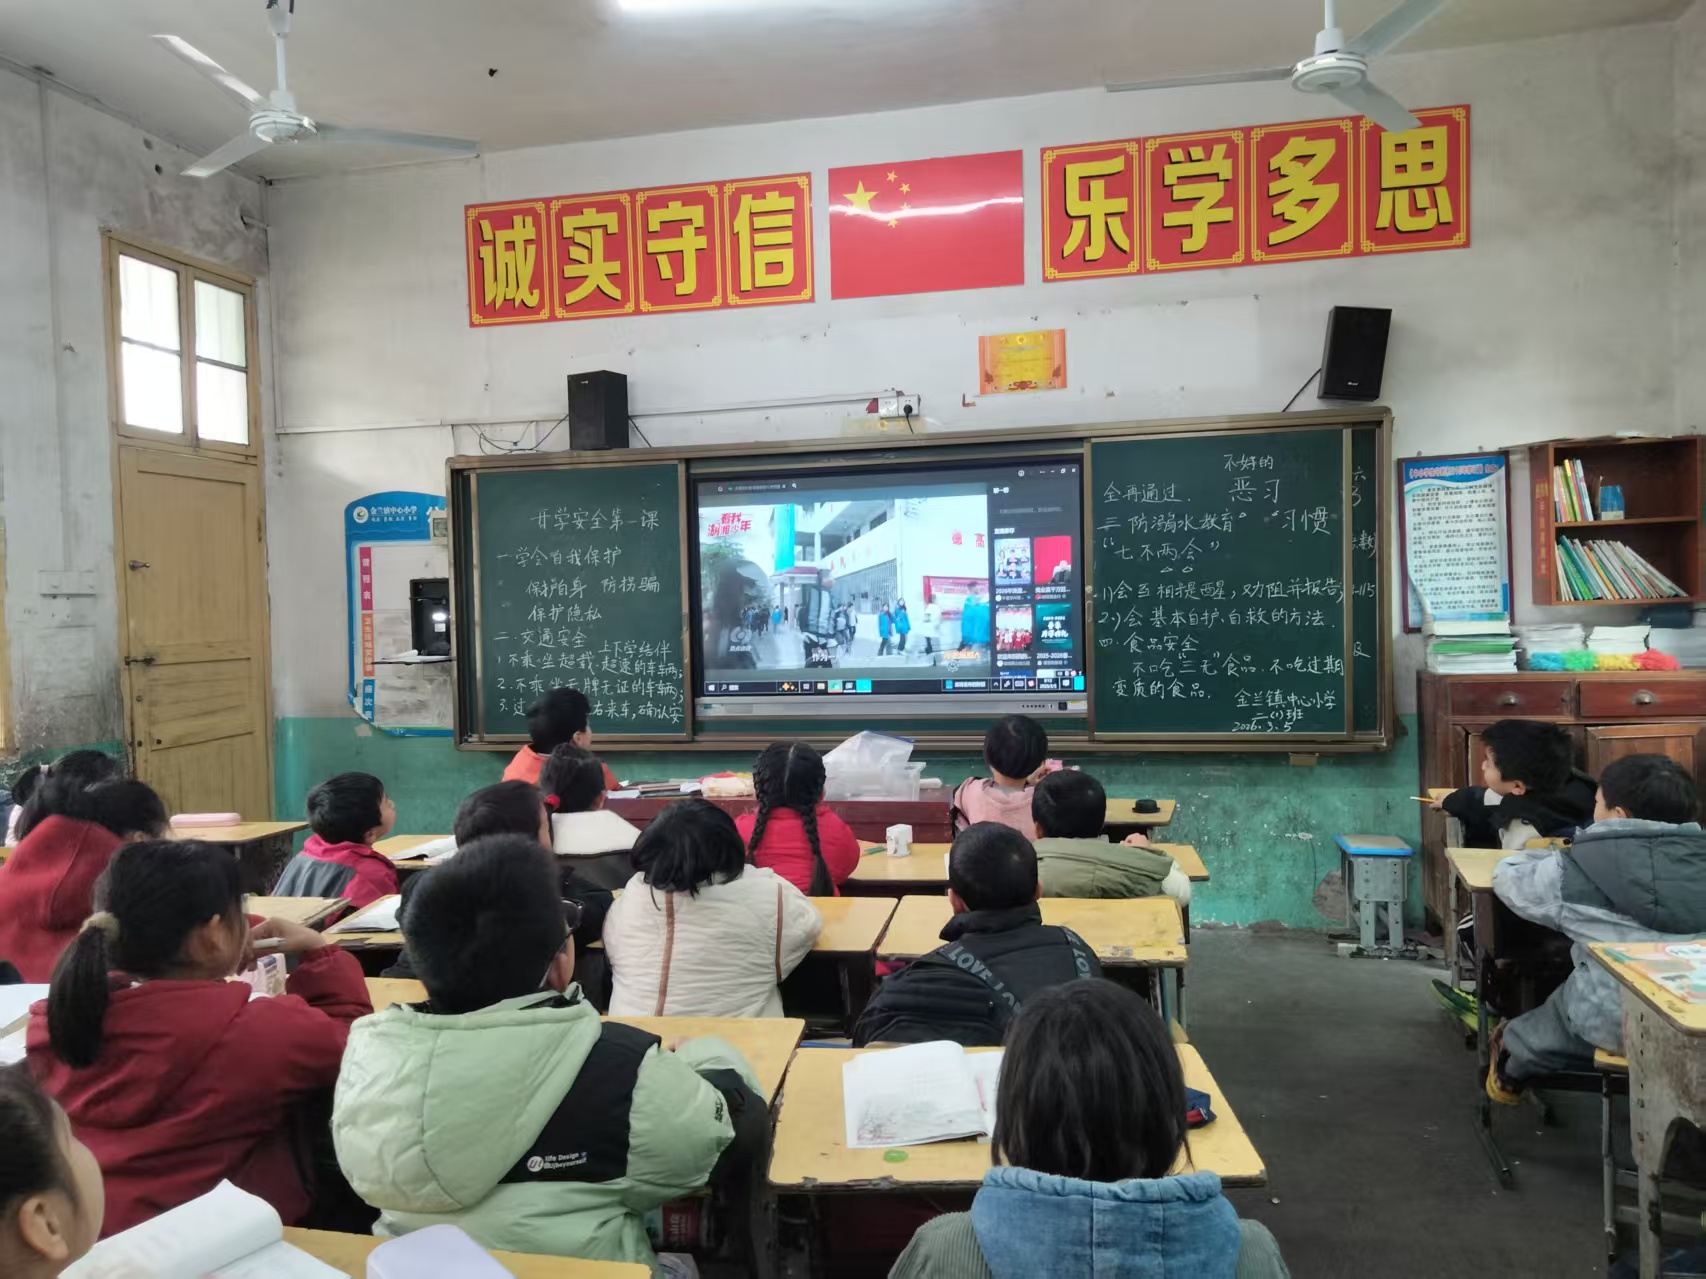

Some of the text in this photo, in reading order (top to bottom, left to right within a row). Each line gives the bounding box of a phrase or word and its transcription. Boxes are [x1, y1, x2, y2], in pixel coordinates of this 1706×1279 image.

[1063, 125, 1453, 262] 乐学多思
[479, 191, 796, 311] 诚实守信
[1223, 453, 1274, 472] 不好的
[1228, 475, 1280, 503] 恶习
[530, 506, 660, 531] 开学安全第一课
[525, 574, 661, 599] 保护自身 防拐骗
[528, 603, 603, 623] 保护隐私
[597, 640, 673, 664] 上下学结伴
[1234, 688, 1337, 710] 金兰镇中心小学
[947, 945, 993, 980] LOVE
